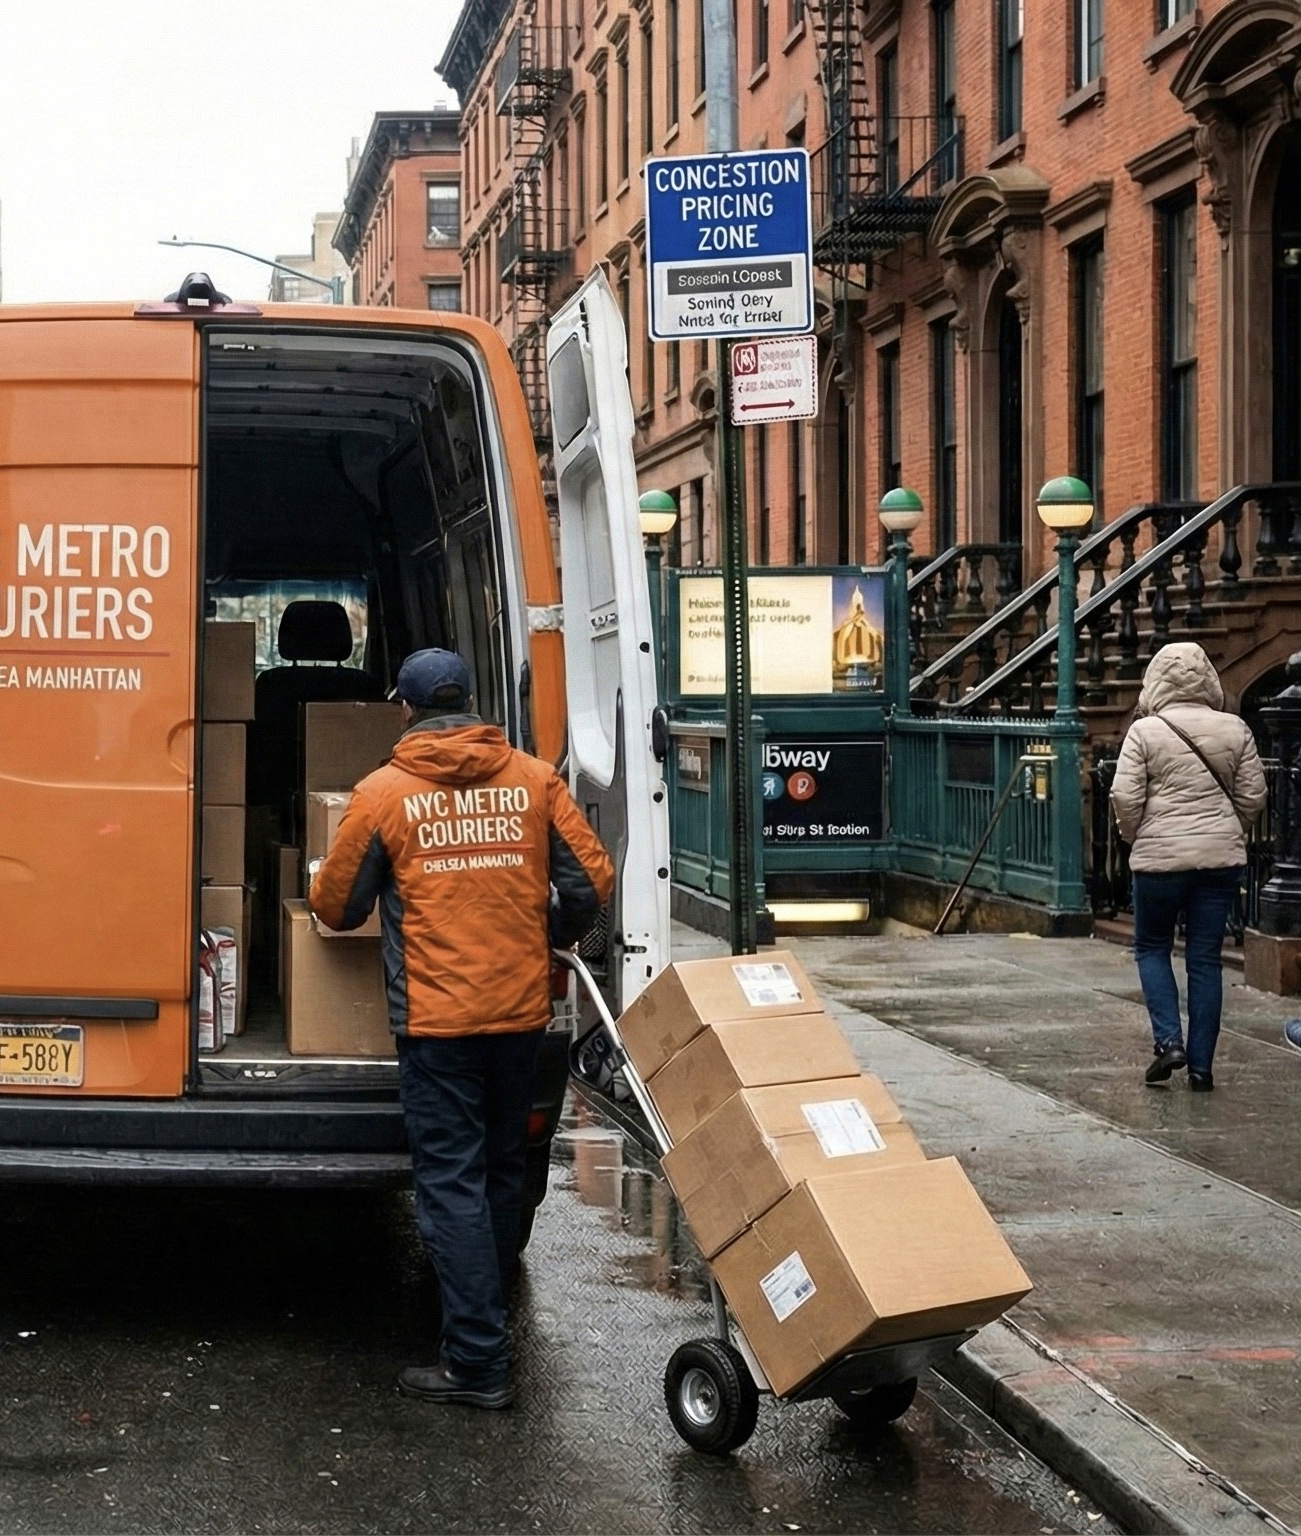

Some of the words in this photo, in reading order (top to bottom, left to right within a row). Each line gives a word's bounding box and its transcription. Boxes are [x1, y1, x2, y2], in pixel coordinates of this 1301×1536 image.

[655, 158, 799, 192] CONCESTION
[682, 192, 773, 221] PRICING
[698, 224, 759, 251] ZONE
[17, 523, 170, 578] METRO
[26, 666, 141, 690] MANHATTAN
[762, 743, 831, 771] bway
[403, 791, 449, 823] NYC
[453, 787, 529, 816] METRO
[417, 816, 524, 849] COURIERS
[423, 856, 467, 874] CHELSEA
[468, 854, 524, 871] MANHATTAN
